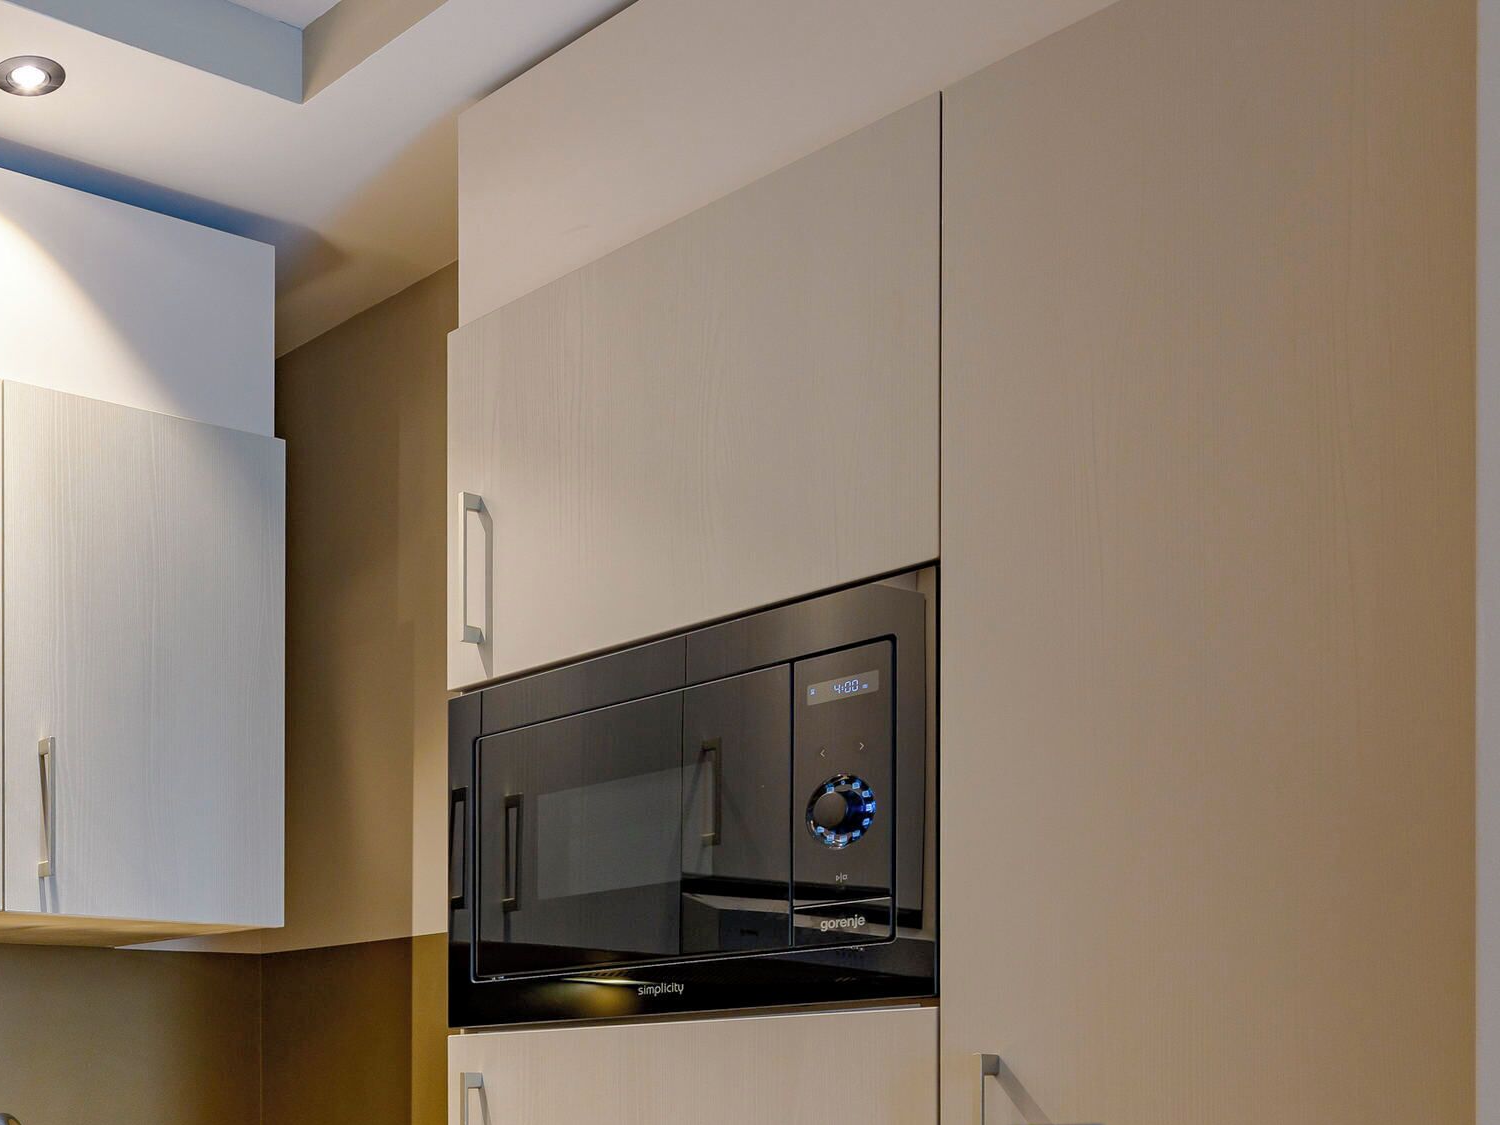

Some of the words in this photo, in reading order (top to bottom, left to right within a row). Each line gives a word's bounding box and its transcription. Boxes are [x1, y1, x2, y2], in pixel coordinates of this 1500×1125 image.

[833, 679, 859, 694] 4:00
[820, 914, 866, 932] gorenje
[638, 982, 685, 997] simplicity
